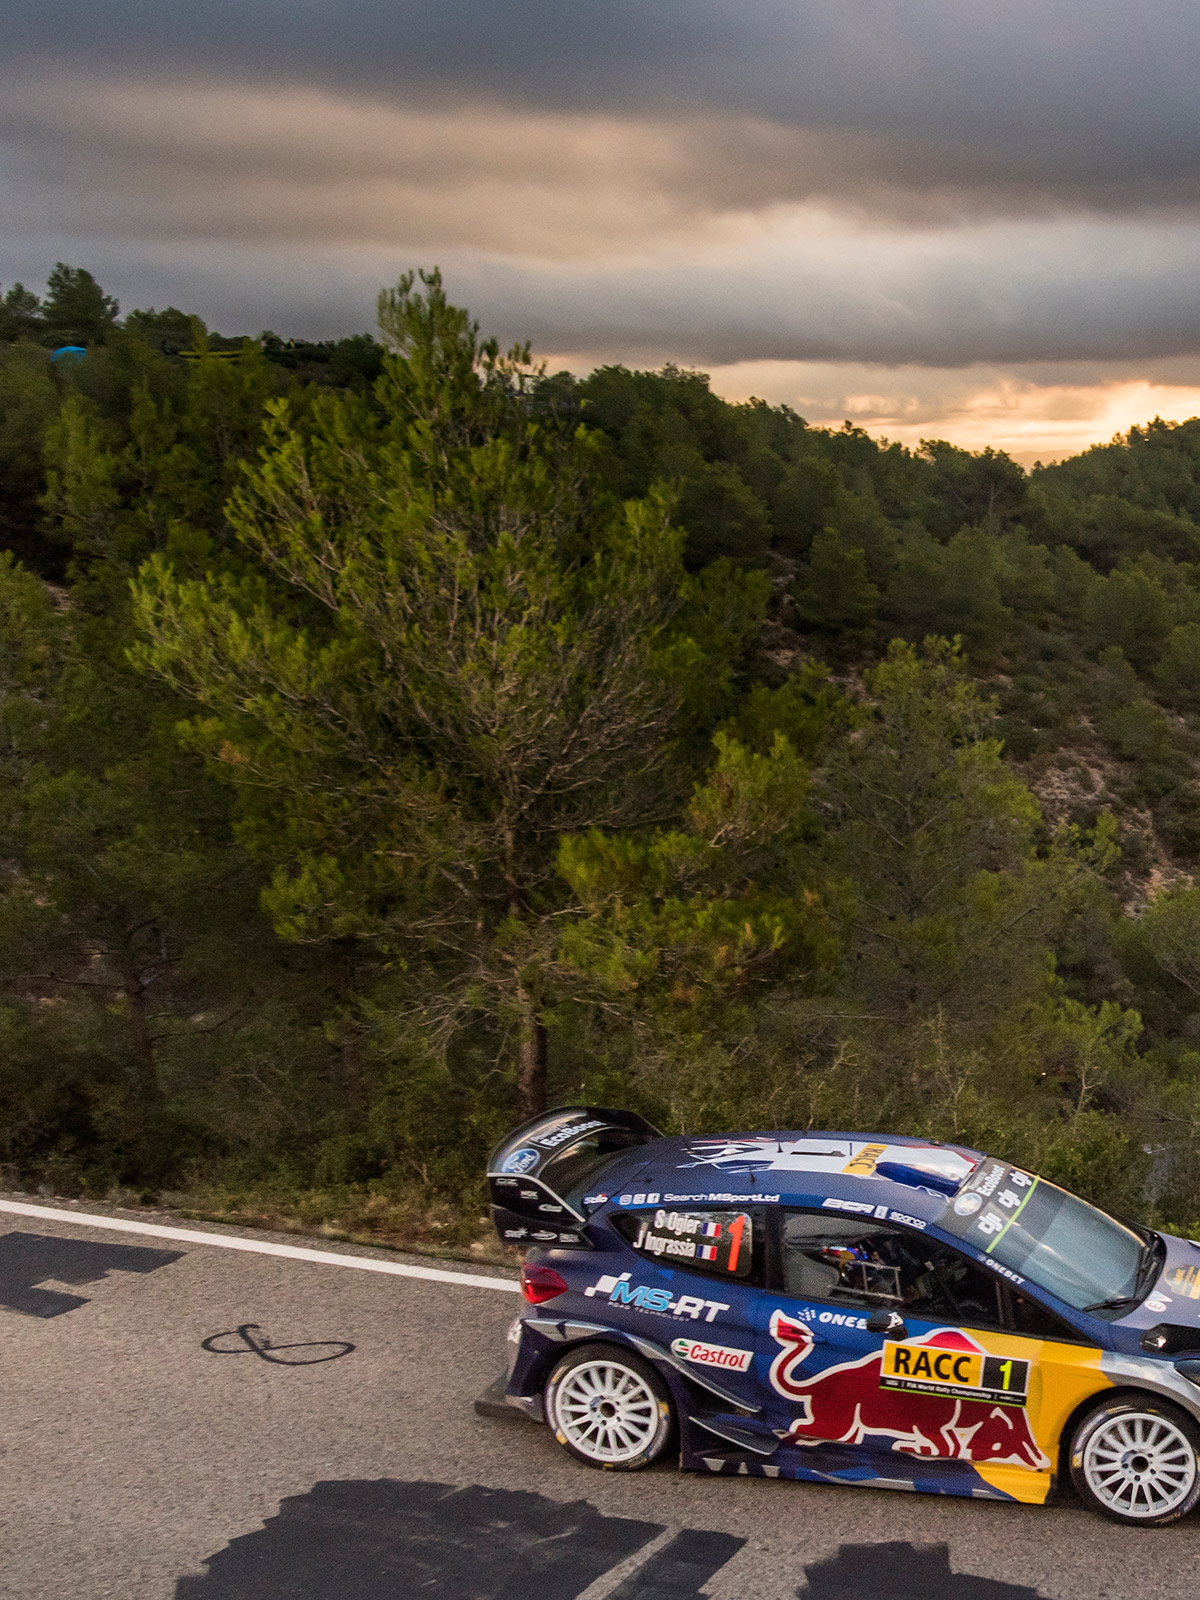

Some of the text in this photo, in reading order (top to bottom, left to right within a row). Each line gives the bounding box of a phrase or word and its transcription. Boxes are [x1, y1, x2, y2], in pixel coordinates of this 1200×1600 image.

[506, 1152, 537, 1173] Ford
[663, 1193, 708, 1203] Search
[654, 1209, 702, 1236] S Ogier
[633, 1222, 697, 1257] J Ingrassia
[728, 1215, 746, 1272] 1
[985, 1258, 1026, 1285] ONEBET
[690, 1344, 746, 1369] Castrol
[893, 1347, 972, 1384] RACC
[999, 1360, 1014, 1391] 1
